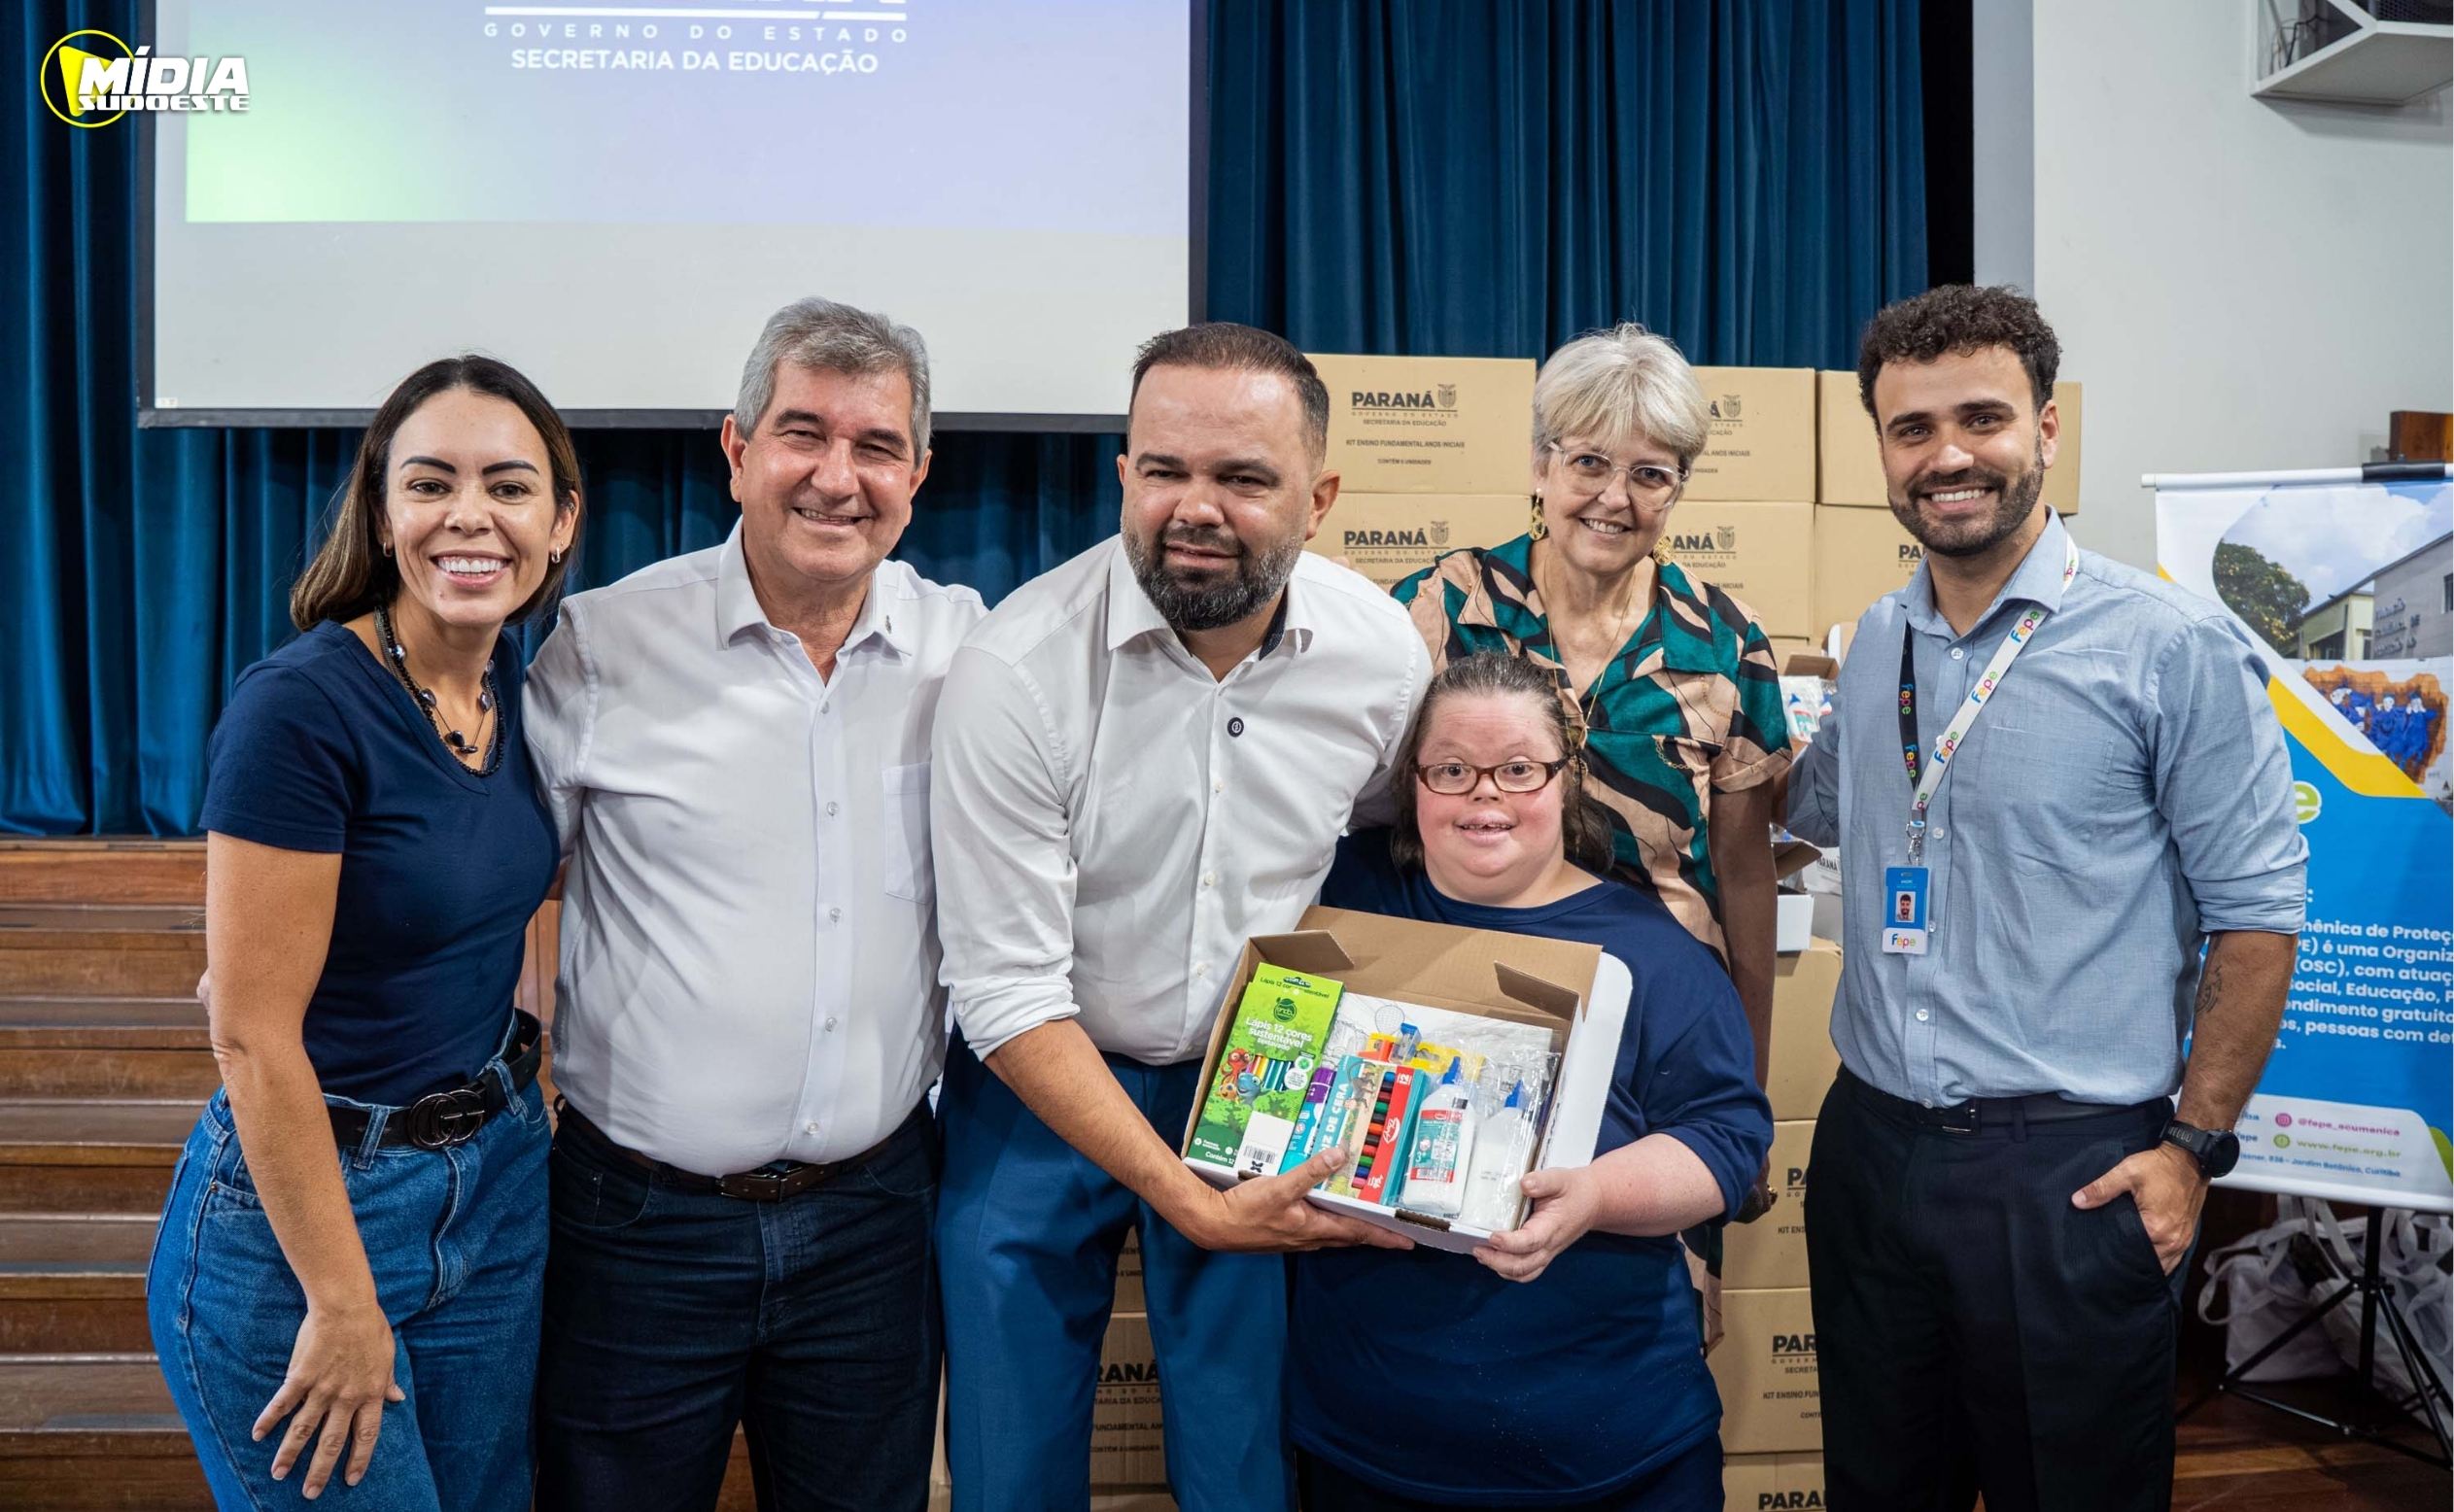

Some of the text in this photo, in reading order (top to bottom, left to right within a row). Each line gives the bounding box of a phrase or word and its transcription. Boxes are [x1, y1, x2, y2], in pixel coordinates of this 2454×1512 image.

[484, 22, 907, 43] GOVERNO DO ESTADO
[510, 49, 879, 75] SECRETARIA DA EDUCAÇÃO
[1352, 391, 1435, 408] PARANÁ
[1344, 528, 1428, 545] PARANÁ
[1674, 533, 1714, 550] ANÁ
[1891, 933, 1916, 949] fepe
[2366, 923, 2389, 939] de
[2393, 926, 2452, 945] Proteç
[2323, 940, 2333, 953] é
[2336, 943, 2378, 957] uma
[2295, 954, 2453, 986] (OSC), com atuaç
[2345, 982, 2440, 1004] Educação,
[2284, 997, 2378, 1018] endimento
[1246, 1016, 1312, 1042] Lápis 12 cores
[1248, 1027, 1304, 1048] sustentável
[2304, 1020, 2380, 1039] pessoas
[2383, 1028, 2424, 1042] com
[1258, 1038, 1291, 1051] sextavado
[1400, 1073, 1409, 1084] 12
[1331, 1082, 1349, 1114] CERA
[1326, 1116, 1338, 1133] DE
[1205, 1151, 1227, 1162] Contém
[1772, 1334, 1816, 1353] PAR
[1777, 1391, 1803, 1399] ENSINO
[1758, 1490, 1823, 1510] PARA
